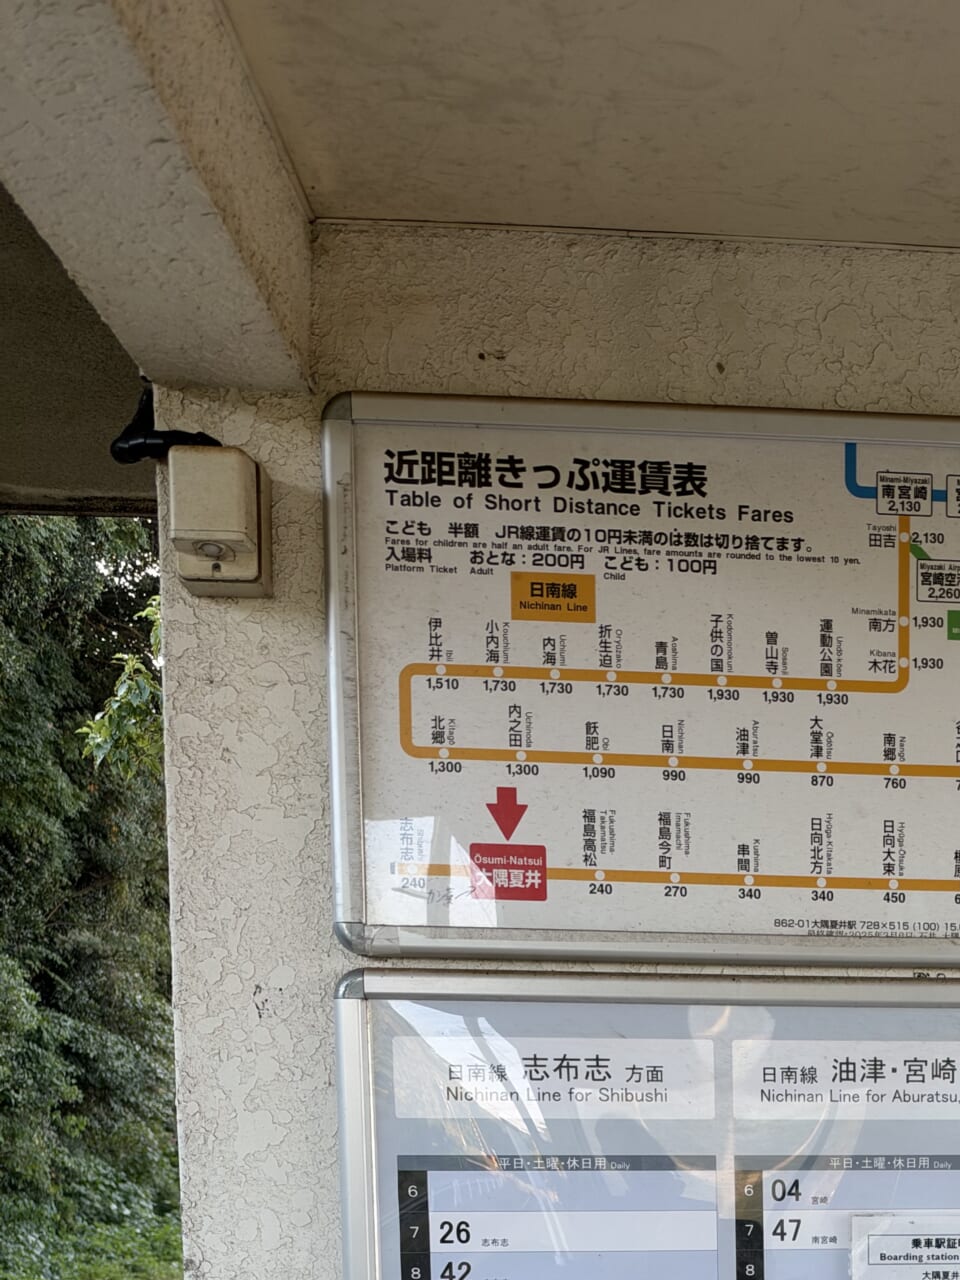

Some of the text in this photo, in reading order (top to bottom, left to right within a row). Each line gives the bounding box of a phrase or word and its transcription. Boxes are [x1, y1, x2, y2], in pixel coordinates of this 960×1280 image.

[384, 449, 708, 498] 近距離きっぷ運賃表
[882, 485, 928, 500] 南宮崎
[386, 490, 795, 523] Table of Short Distance Tickets Fares
[888, 501, 921, 513] 2,130
[385, 520, 431, 536] こども
[448, 523, 479, 539] 半額
[867, 524, 896, 533] Tayoshi
[869, 533, 897, 548] 田吉
[912, 532, 944, 545] 2,130
[385, 546, 432, 563] 入場料
[385, 564, 626, 580] Platform Ticket Adult Child
[530, 582, 577, 599] 日南線
[928, 588, 960, 600] 2,260
[519, 601, 588, 612] Nichinan Line
[852, 608, 896, 616] Minamikata
[868, 618, 896, 632] 南方
[912, 617, 944, 629] 1,930
[428, 617, 443, 662] 伊比井
[485, 619, 500, 664] 小内海
[598, 624, 613, 668] 折生迫
[710, 614, 724, 673] 子供の国
[542, 637, 556, 666] 内海
[655, 641, 668, 670] 青島
[765, 631, 779, 675] 曽山寺
[820, 619, 833, 677] 運動公園
[870, 650, 896, 658] Kibana
[868, 660, 896, 674] 木花
[912, 658, 944, 669] 1,930
[426, 678, 459, 691] 1,510
[483, 680, 516, 693] 1,730
[539, 682, 573, 695] 1,730
[596, 684, 629, 698] 1,730
[652, 686, 685, 700] 1,730
[707, 689, 740, 702] 1,930
[762, 691, 794, 704] 1,930
[817, 693, 849, 706] 1,930
[431, 715, 446, 745] 北郷
[508, 704, 522, 748] 内之田
[585, 721, 599, 751] 飫肥
[661, 724, 674, 754] 日南
[736, 727, 750, 756] 油津
[810, 716, 823, 759] 大堂津
[883, 733, 896, 762] 南郷
[428, 761, 462, 774] 1,300
[506, 764, 539, 776] 1,300
[582, 767, 616, 779] 1,090
[662, 769, 686, 781] 990
[737, 772, 760, 784] 990
[811, 775, 834, 787] 870
[883, 778, 907, 790] 760
[400, 817, 415, 861] 志布志
[582, 809, 598, 867] 福島高松
[658, 811, 672, 870] 福島今町
[810, 818, 823, 874] 日向北方
[883, 820, 896, 876] 日向大束
[737, 843, 750, 873] 串間
[401, 877, 426, 889] 240
[475, 869, 542, 889] 大隅夏井
[589, 883, 613, 895] 240
[664, 886, 688, 898] 270
[738, 888, 761, 900] 340
[811, 890, 834, 902] 340
[883, 892, 906, 904] 450
[774, 918, 857, 930] 862-01大隅夏井駅
[912, 921, 940, 932] (100)
[449, 1054, 664, 1083] 日南線 志布志 方面
[762, 1066, 818, 1085] 日南線
[831, 1057, 957, 1085] 油津・宮崎
[446, 1086, 668, 1103] Nichinan Line for Shibushi
[760, 1089, 824, 1104] Nichinan
[829, 1090, 860, 1104] Line
[865, 1089, 887, 1104] for
[892, 1089, 960, 1105] Aburatsu,
[499, 1157, 630, 1171] 平日・土曜・休日用 Daily
[829, 1157, 953, 1171] 平日・土曜・休日用 Daily
[771, 1179, 829, 1205] 04 宮崎
[439, 1220, 509, 1247] 26 志布志
[771, 1219, 838, 1245] 47 南宮崎
[880, 1252, 923, 1263] Boarding
[926, 1252, 959, 1262] station
